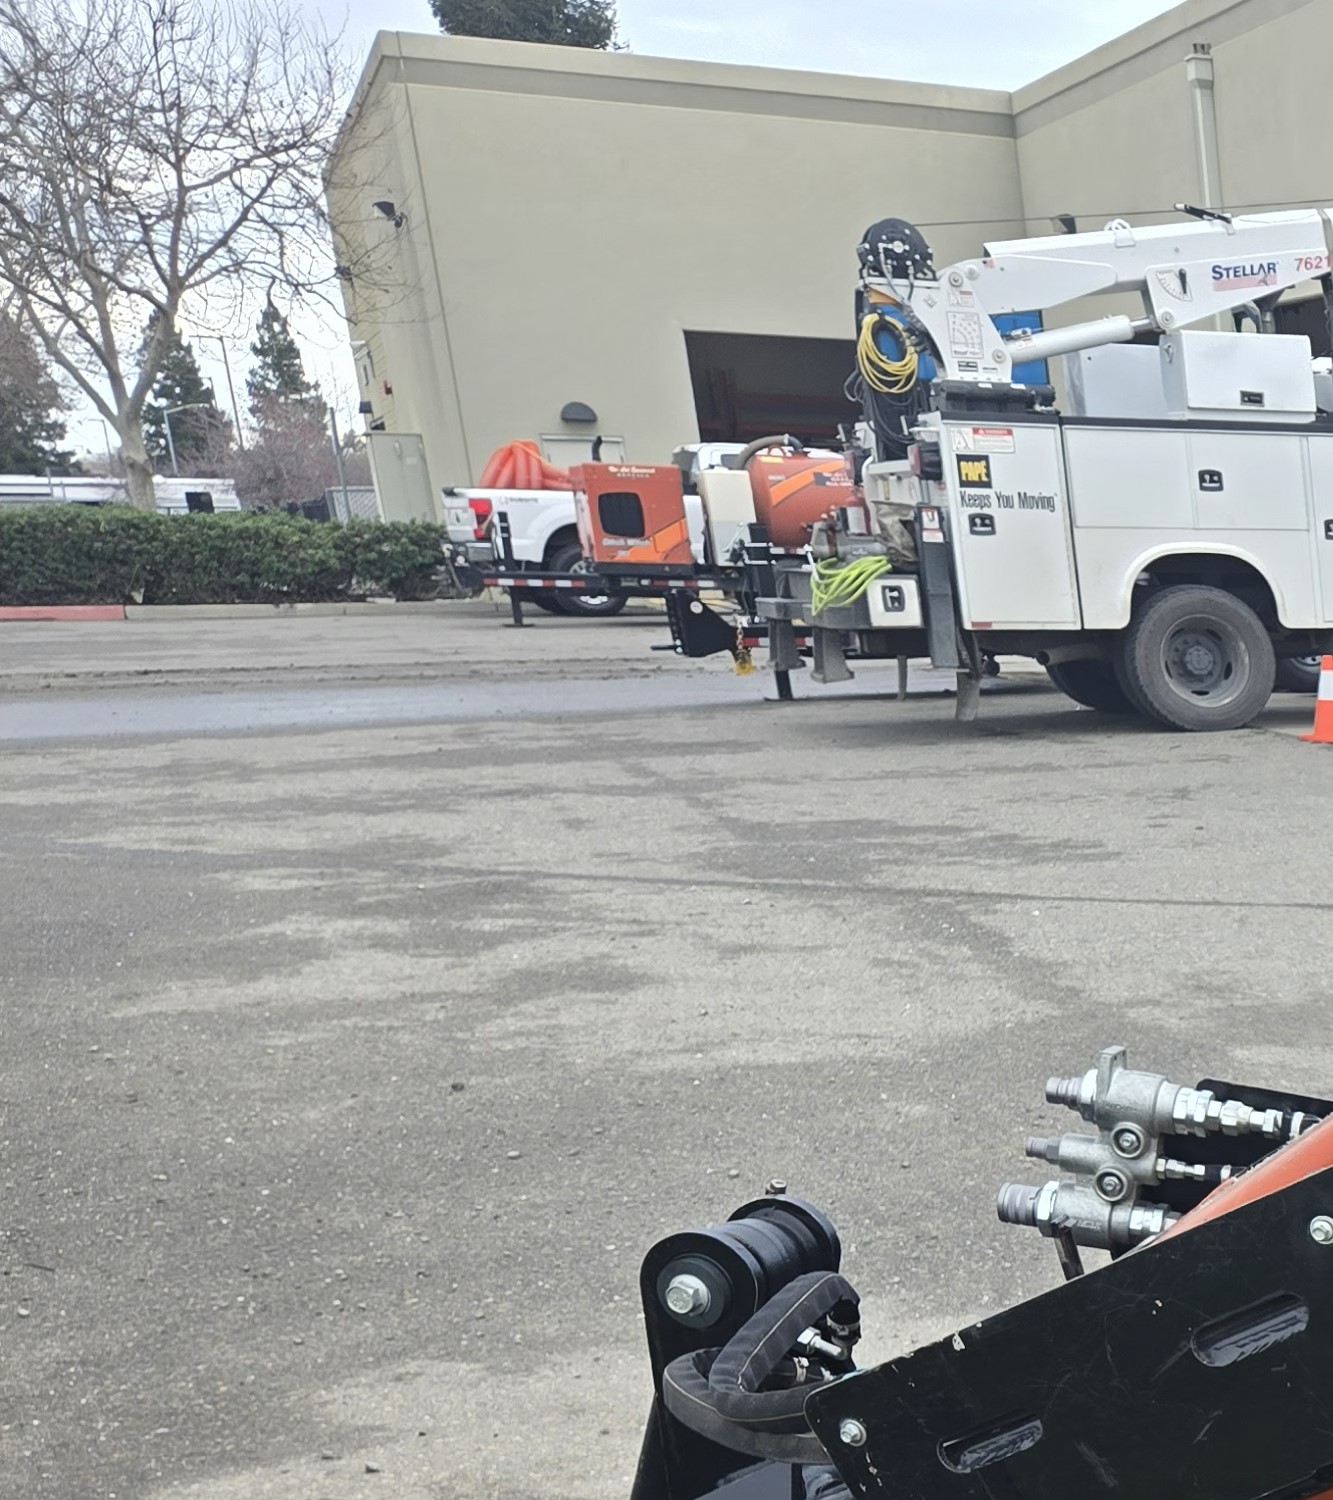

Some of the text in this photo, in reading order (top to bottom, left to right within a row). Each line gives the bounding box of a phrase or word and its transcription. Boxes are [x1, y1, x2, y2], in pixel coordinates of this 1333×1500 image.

[1211, 262, 1277, 280] STELLAR
[960, 490, 1055, 513] Keeps You Moving
